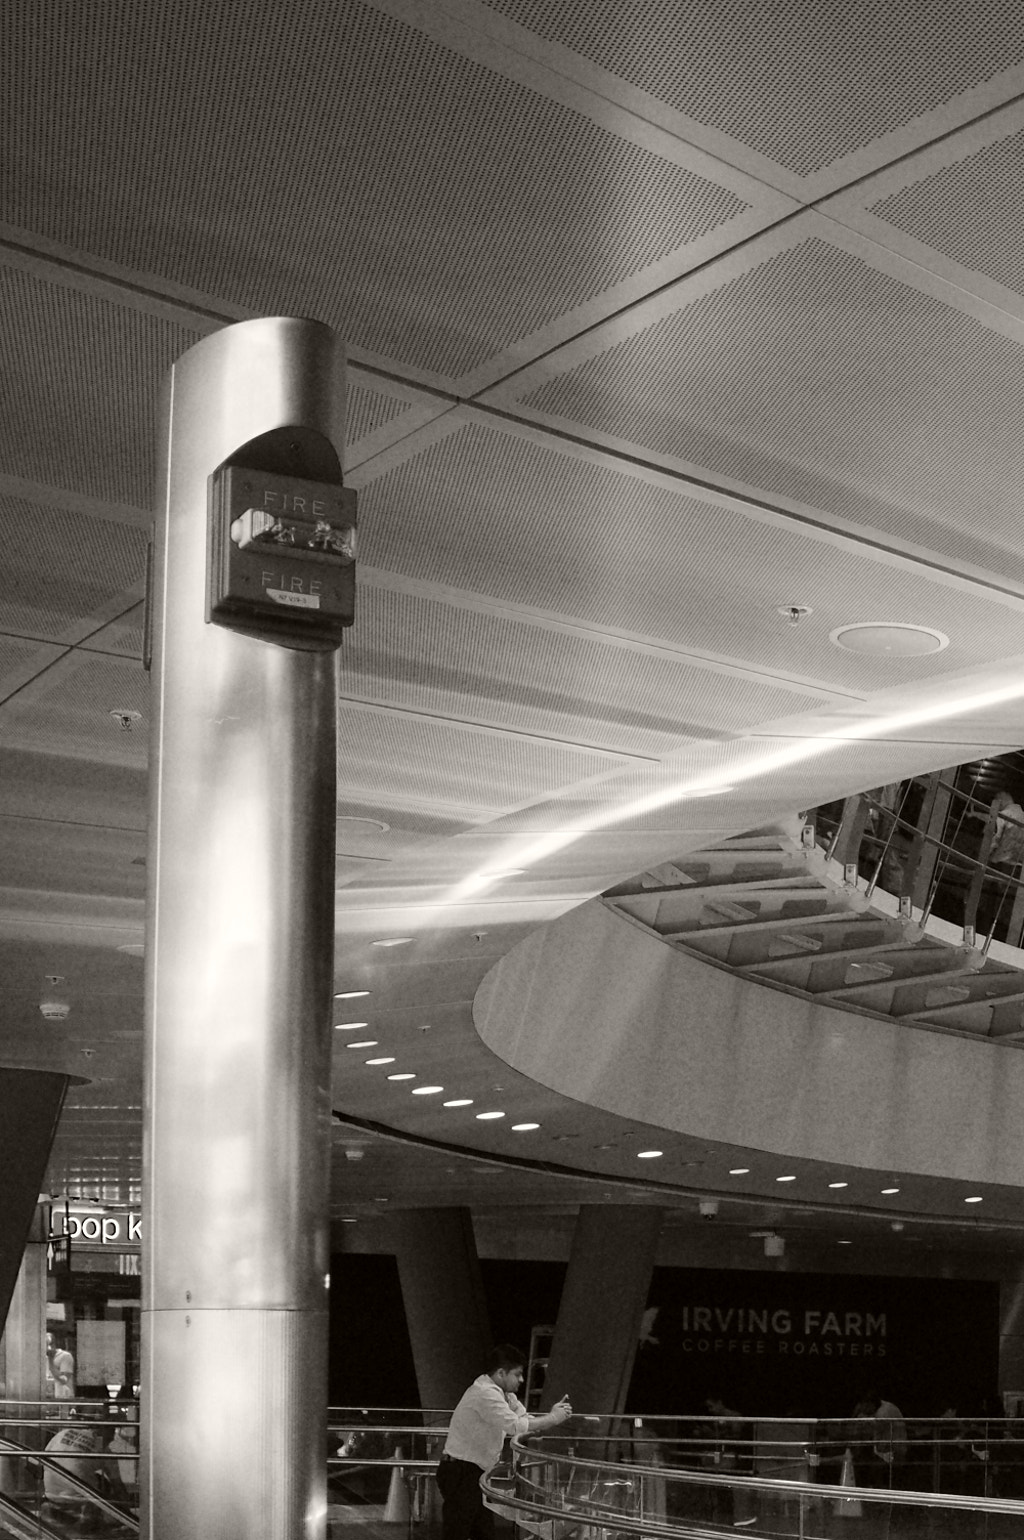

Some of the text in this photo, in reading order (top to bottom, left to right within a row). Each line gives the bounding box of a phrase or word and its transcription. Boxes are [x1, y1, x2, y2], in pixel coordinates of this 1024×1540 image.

[264, 490, 327, 517] FIRE
[262, 571, 322, 596] FIRE
[63, 1217, 120, 1243] pop
[682, 1306, 887, 1337] IRVING FARM
[681, 1338, 887, 1358] COFFEE ROASTERS
